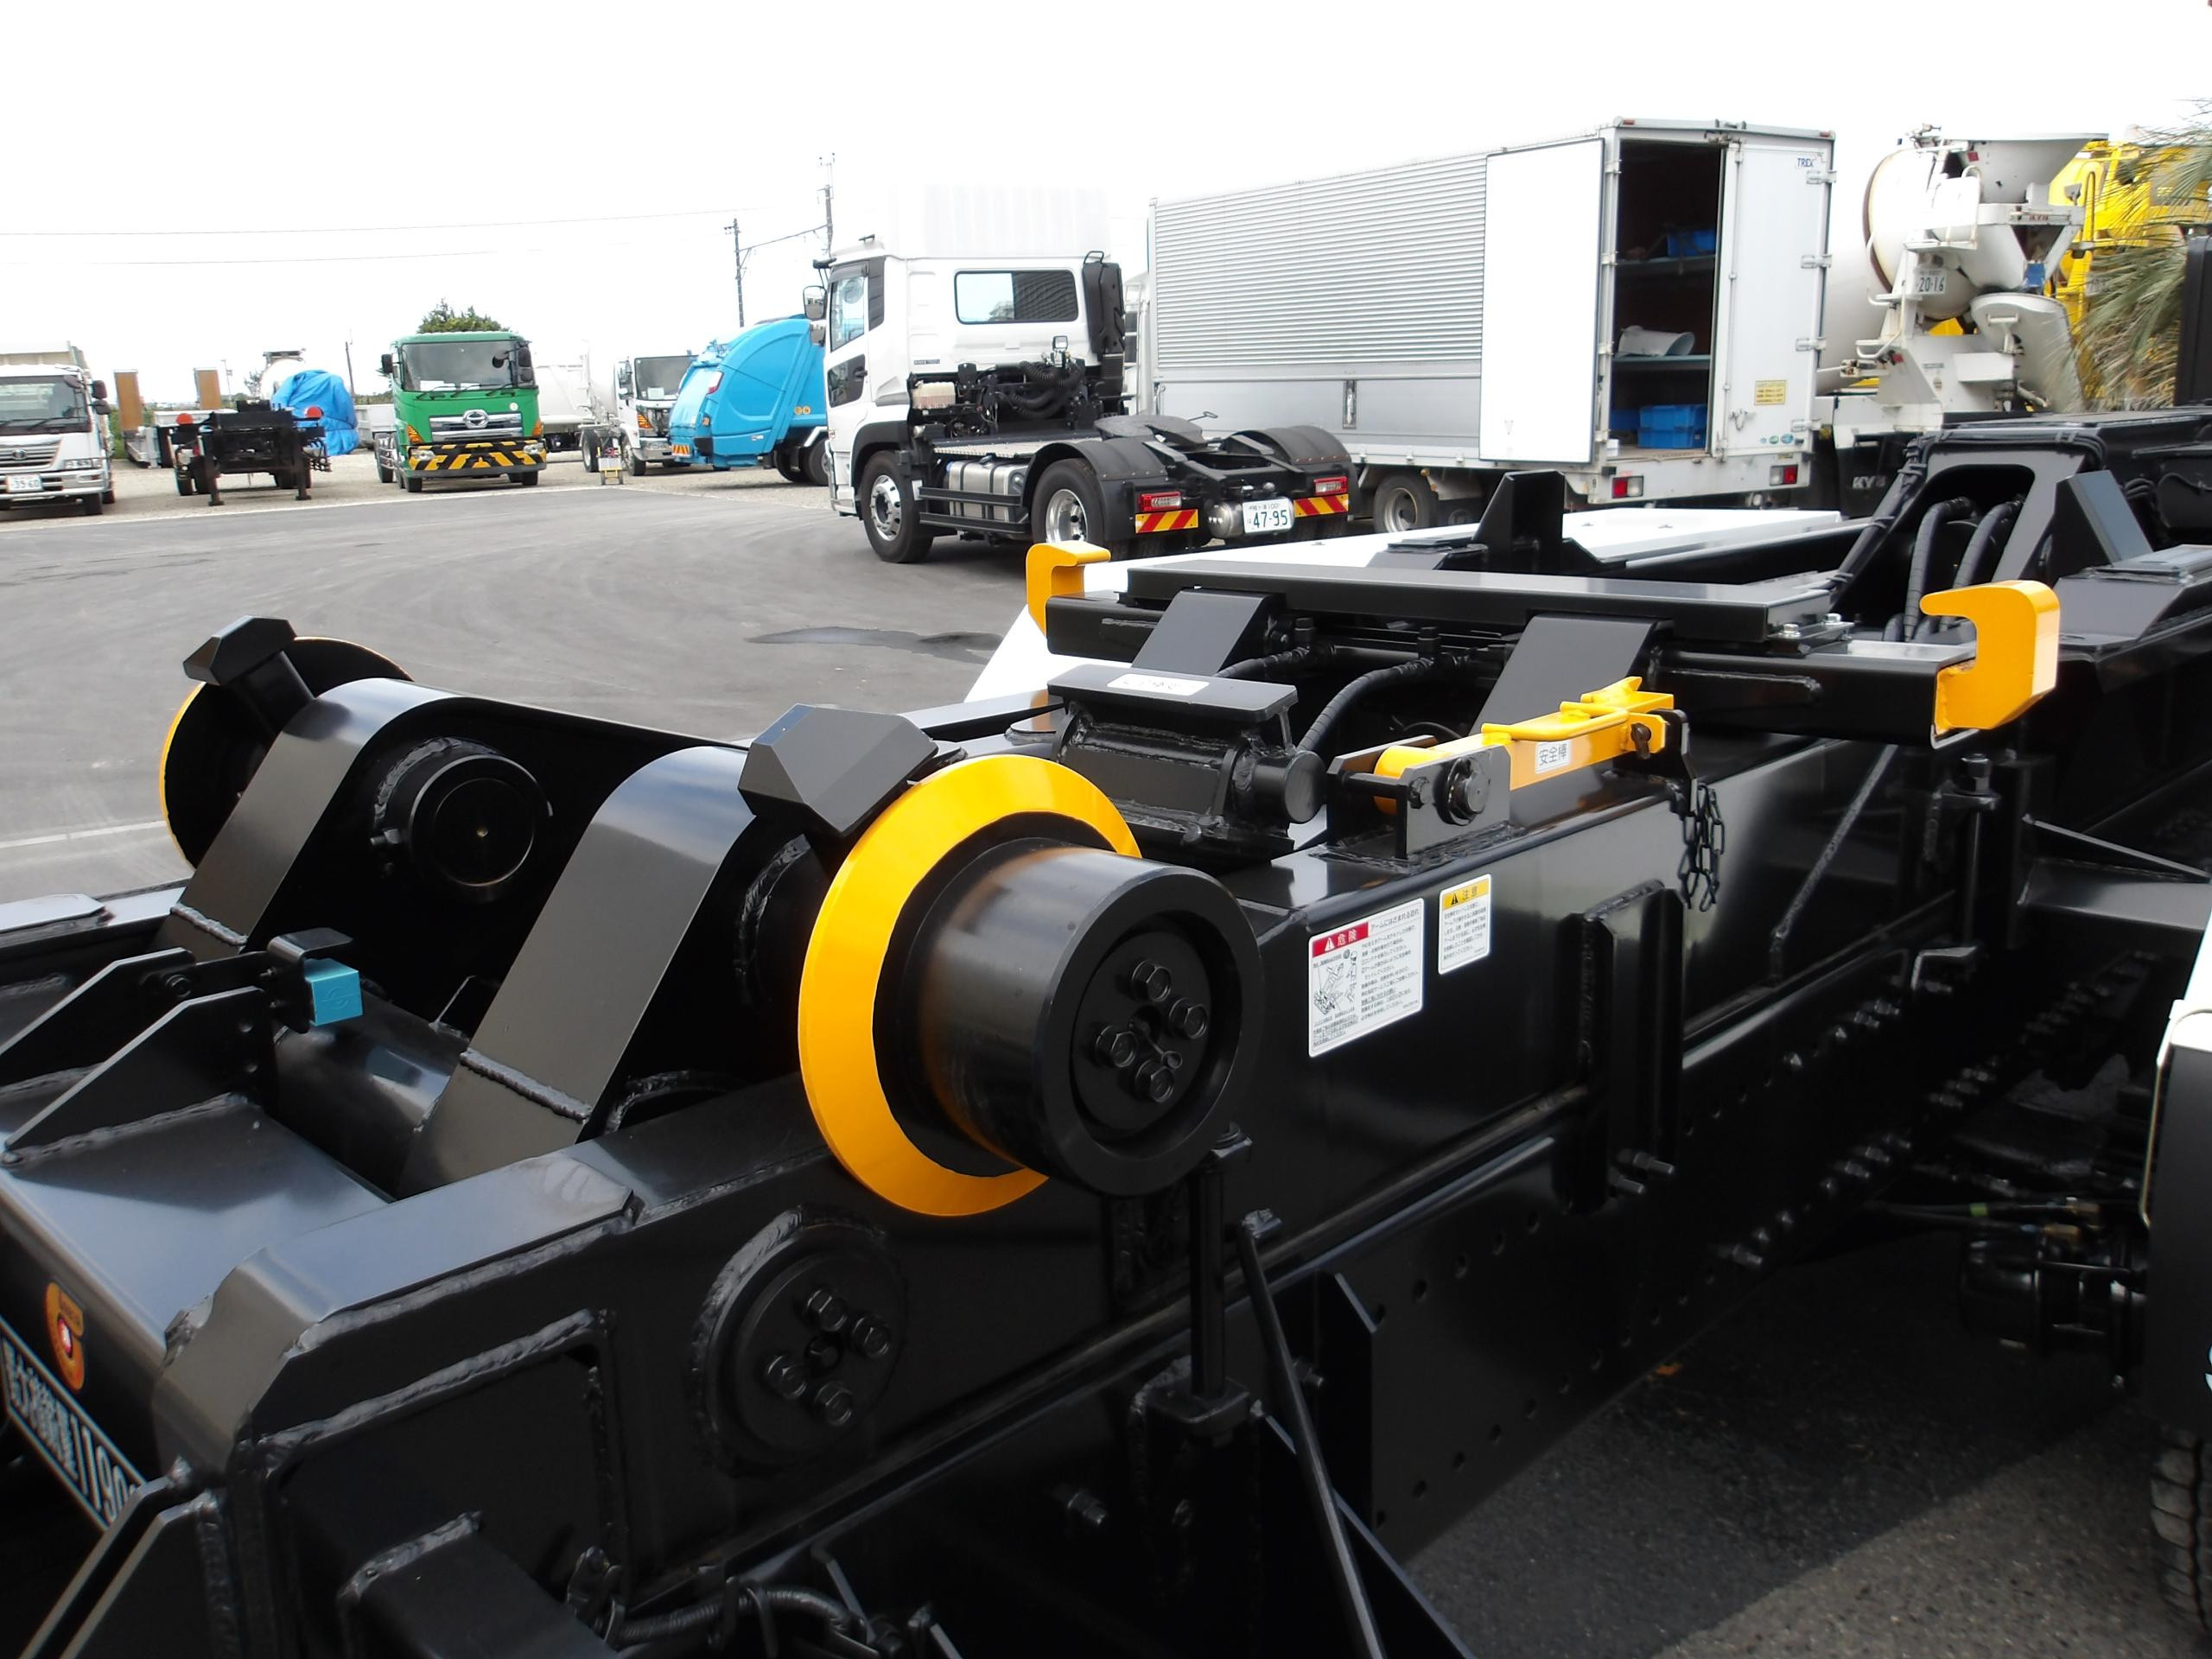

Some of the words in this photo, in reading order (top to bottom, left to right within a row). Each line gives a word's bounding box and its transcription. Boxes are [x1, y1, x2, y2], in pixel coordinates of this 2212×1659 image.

[1918, 276, 1945, 292] 20-16
[1254, 510, 1288, 528] 47-95
[1461, 886, 1478, 900] 注意
[1337, 928, 1357, 947] 危険
